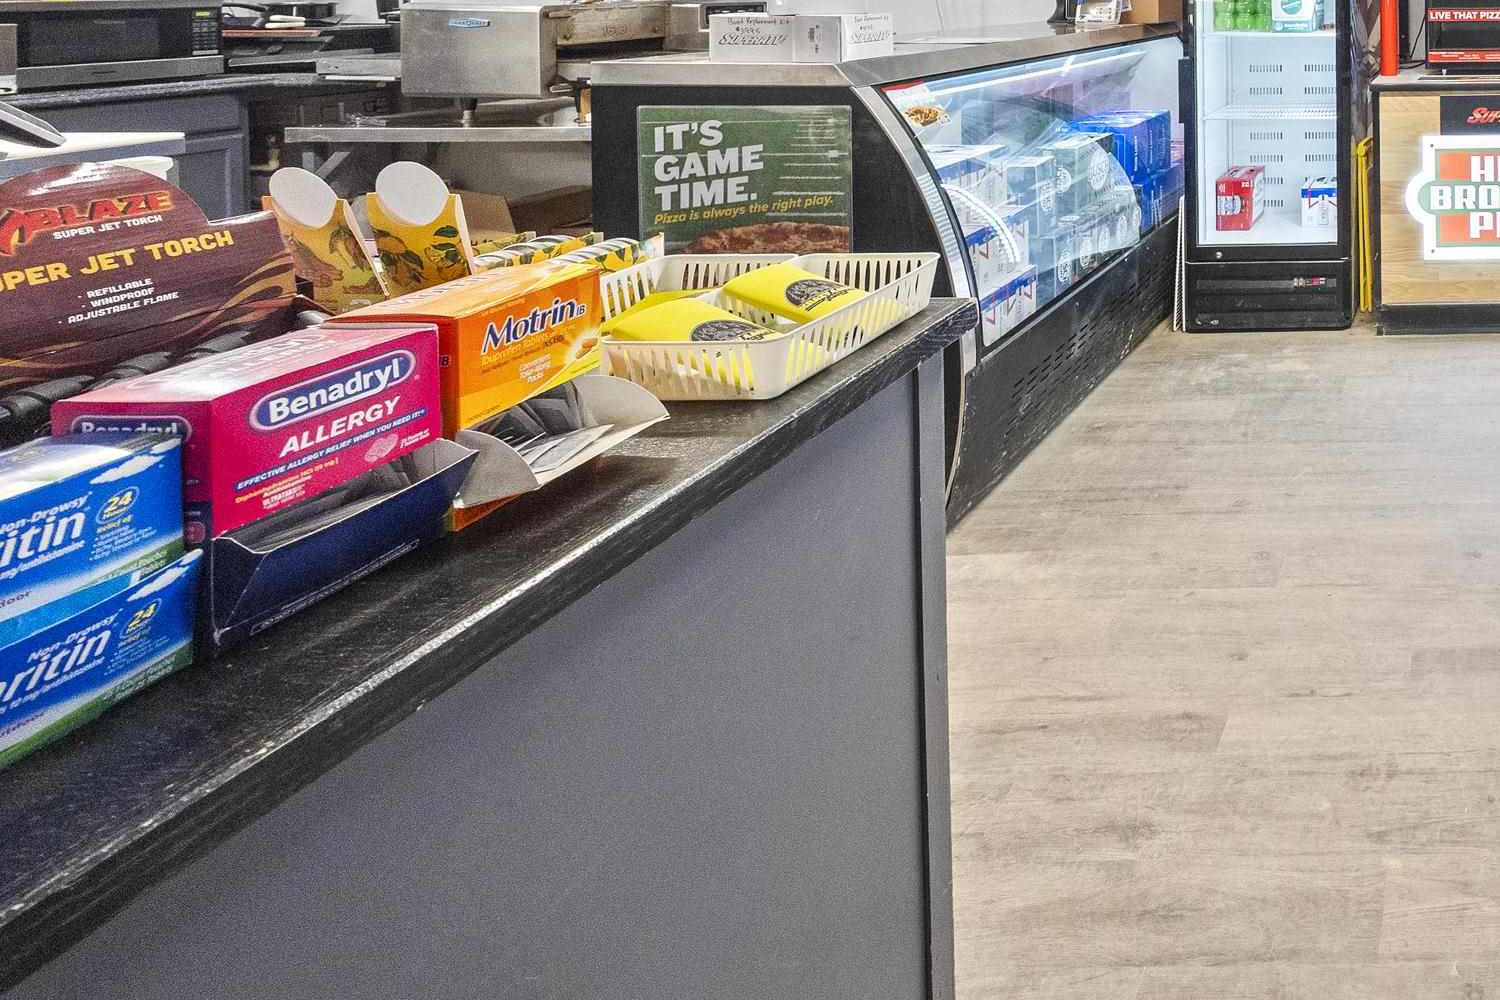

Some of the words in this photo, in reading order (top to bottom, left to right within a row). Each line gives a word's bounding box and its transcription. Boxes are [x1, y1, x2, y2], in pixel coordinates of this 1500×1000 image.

[1430, 12, 1451, 20] LIVE
[1454, 12, 1478, 20] THAT
[654, 119, 723, 153] IT'S
[654, 144, 764, 182] GAME
[654, 176, 757, 212] TIME.
[654, 211, 686, 225] Pizza
[689, 211, 700, 222] is
[702, 206, 746, 221] always
[749, 202, 768, 213] the
[771, 196, 802, 213] right
[803, 193, 834, 208] play.
[53, 224, 95, 240] SUPER
[98, 220, 122, 234] JET
[124, 214, 163, 228] TORCH
[80, 248, 136, 276] JET
[144, 230, 235, 262] TORCH
[87, 278, 153, 299] REFILLABLE
[90, 287, 155, 309] WINDPROOF
[67, 301, 142, 325] ADJUSTABLE
[143, 291, 180, 308] FLAME
[481, 296, 577, 355] Motrin
[267, 357, 403, 425] Benadryl
[279, 395, 401, 458] ALLERGY
[236, 466, 286, 490] EFFECTIVE
[286, 450, 325, 470] ALLERGY
[325, 438, 352, 456] RELIEF
[352, 430, 377, 447] WHEN
[376, 423, 393, 437] YOU
[104, 491, 133, 513] 24
[0, 511, 87, 570] itin
[128, 602, 156, 628] 24
[28, 611, 122, 662] Non-Drowsy
